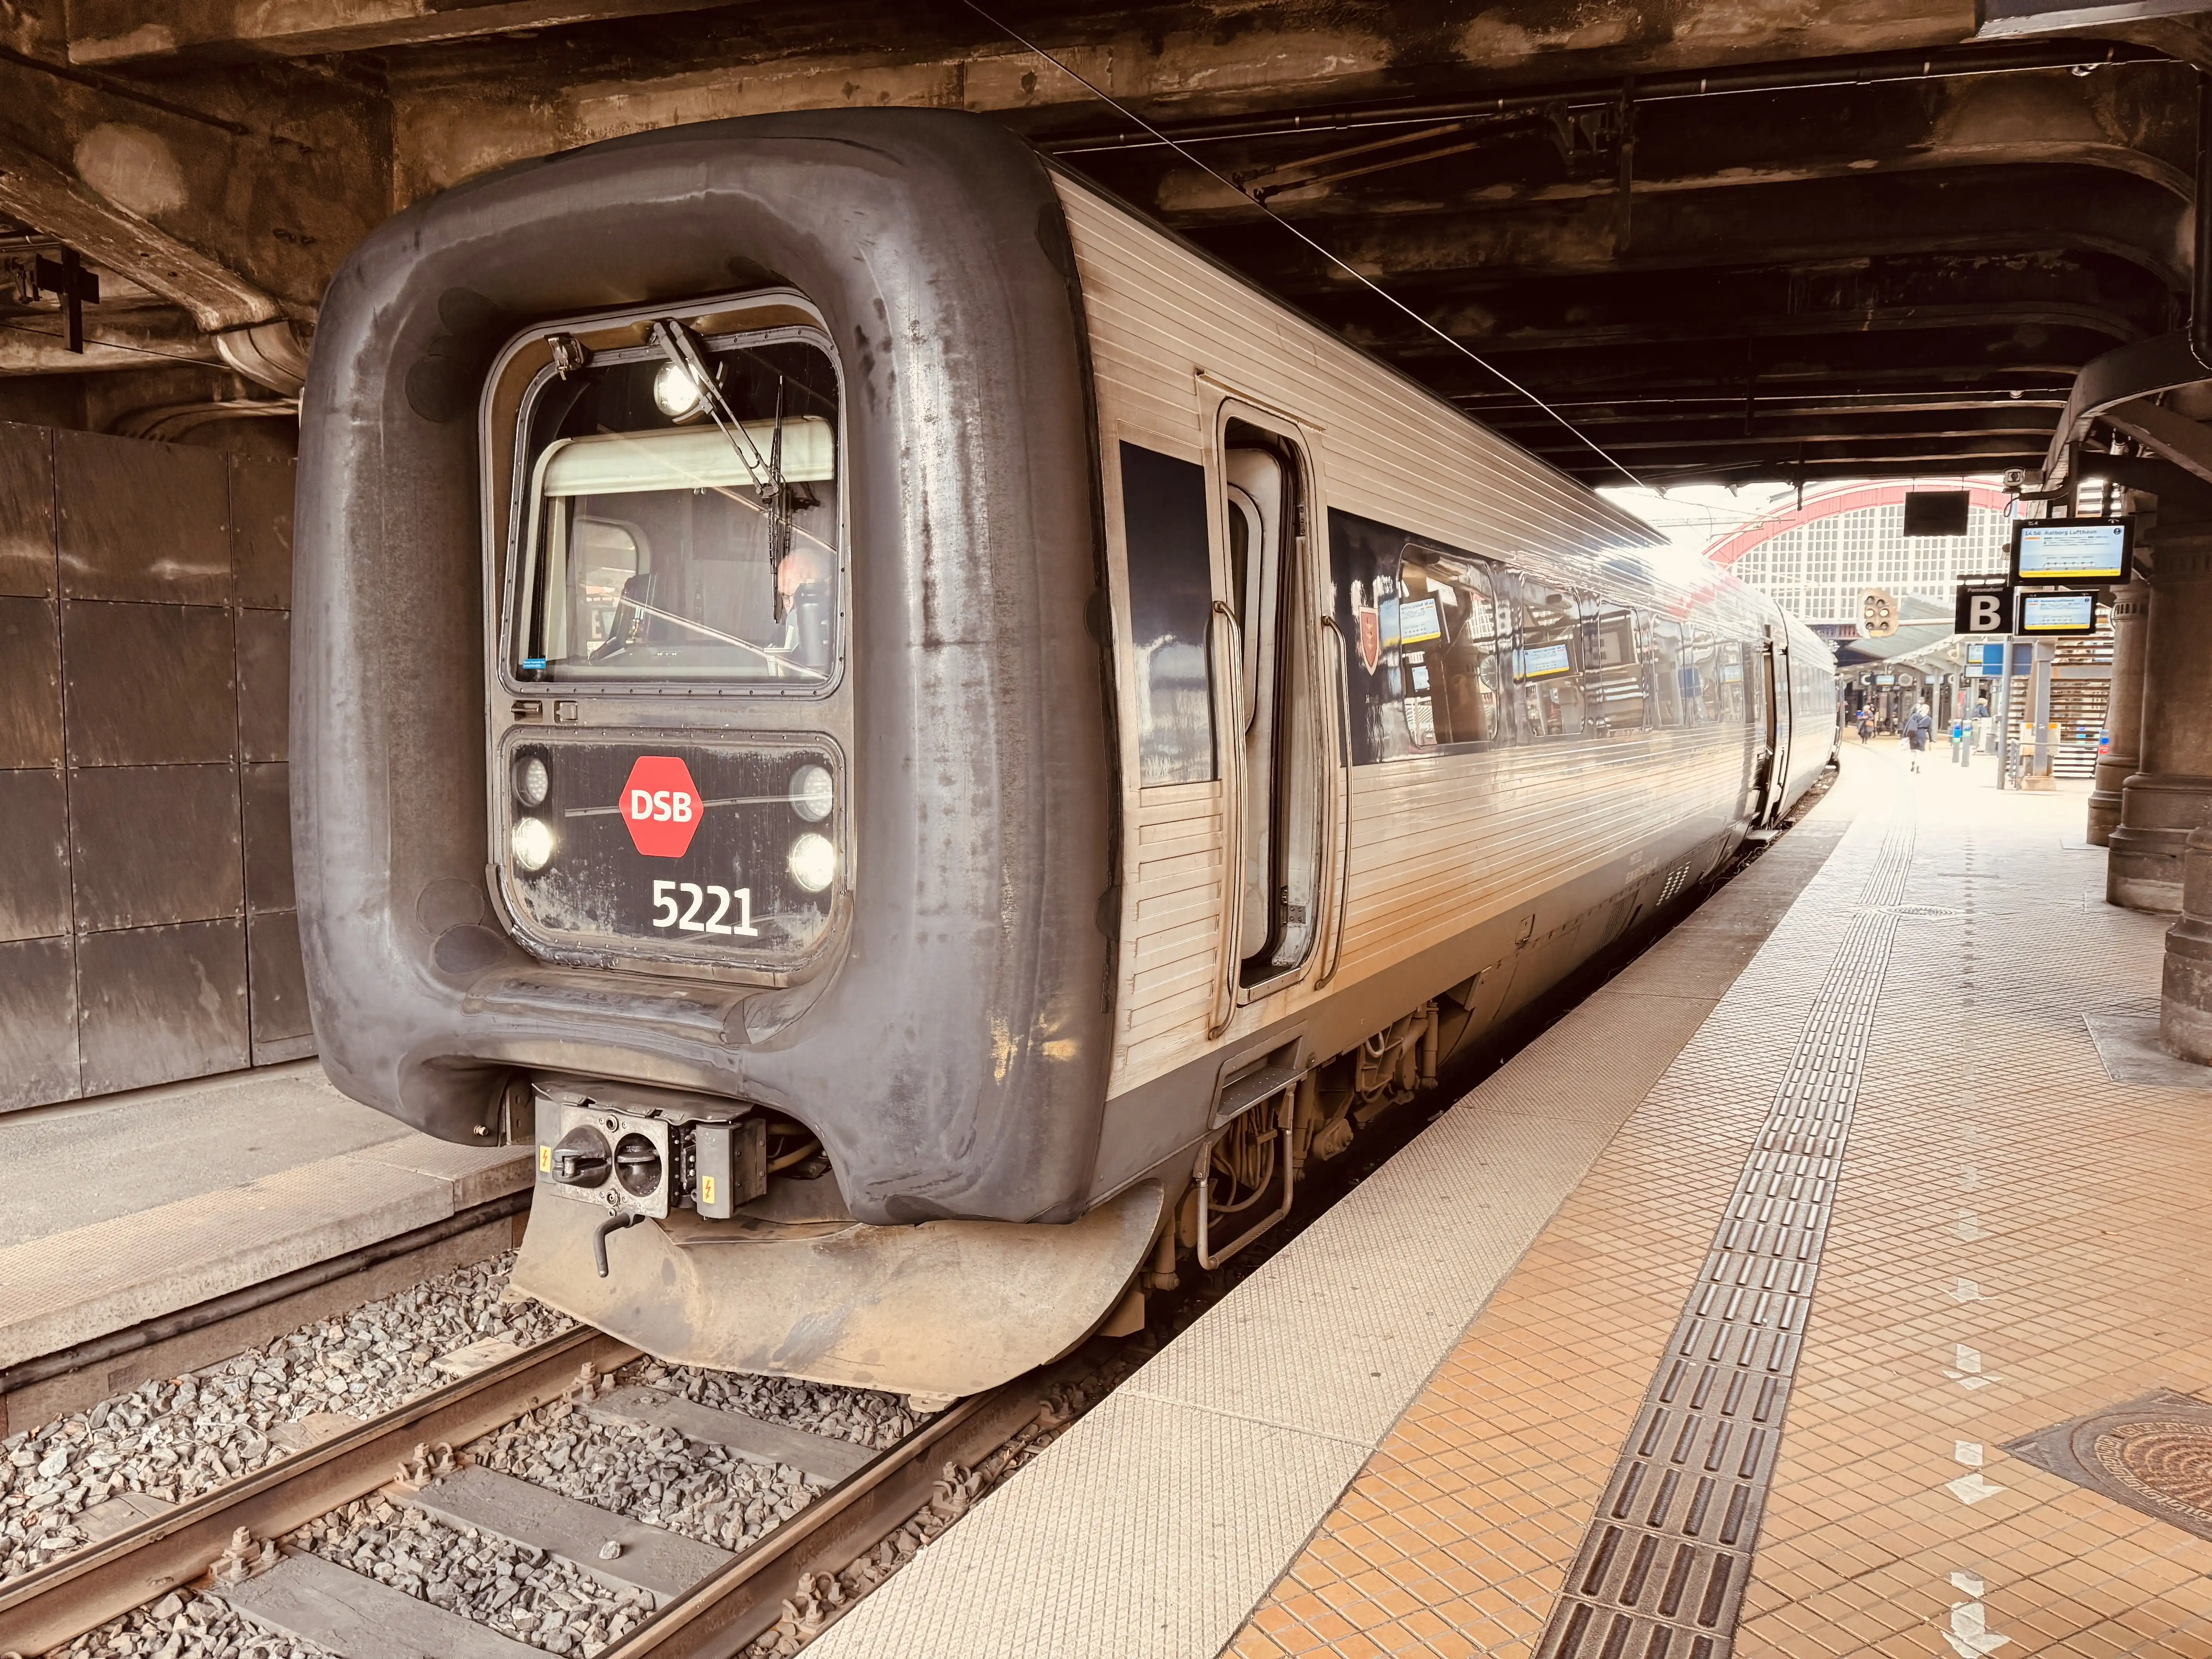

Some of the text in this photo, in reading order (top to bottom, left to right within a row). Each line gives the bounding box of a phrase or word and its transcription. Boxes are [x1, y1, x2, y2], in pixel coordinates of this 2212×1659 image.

[1970, 595, 2001, 631] B
[631, 790, 692, 822] DSB
[653, 880, 758, 937] 5221
